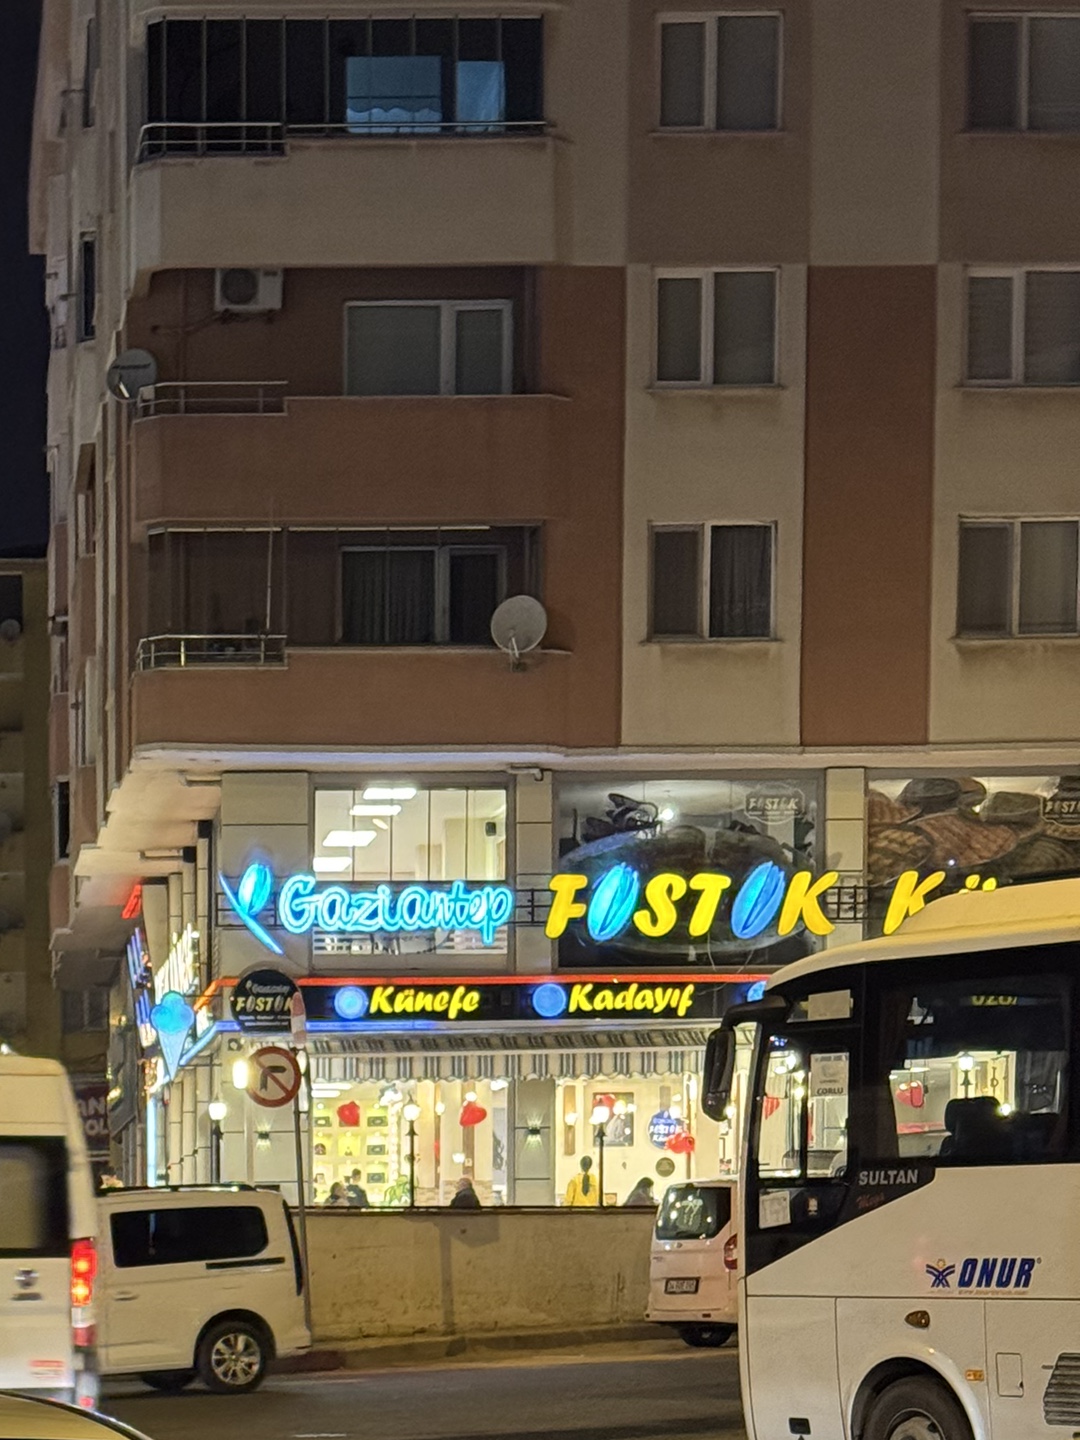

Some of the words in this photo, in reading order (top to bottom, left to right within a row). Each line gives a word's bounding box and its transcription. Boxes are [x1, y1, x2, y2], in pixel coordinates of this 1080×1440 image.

[278, 874, 514, 945] Gaziantep
[369, 985, 480, 1019] Künefe
[568, 983, 695, 1017] Kadayıf
[858, 1169, 918, 1186] SULTAN
[957, 1257, 1036, 1288] ONUR
